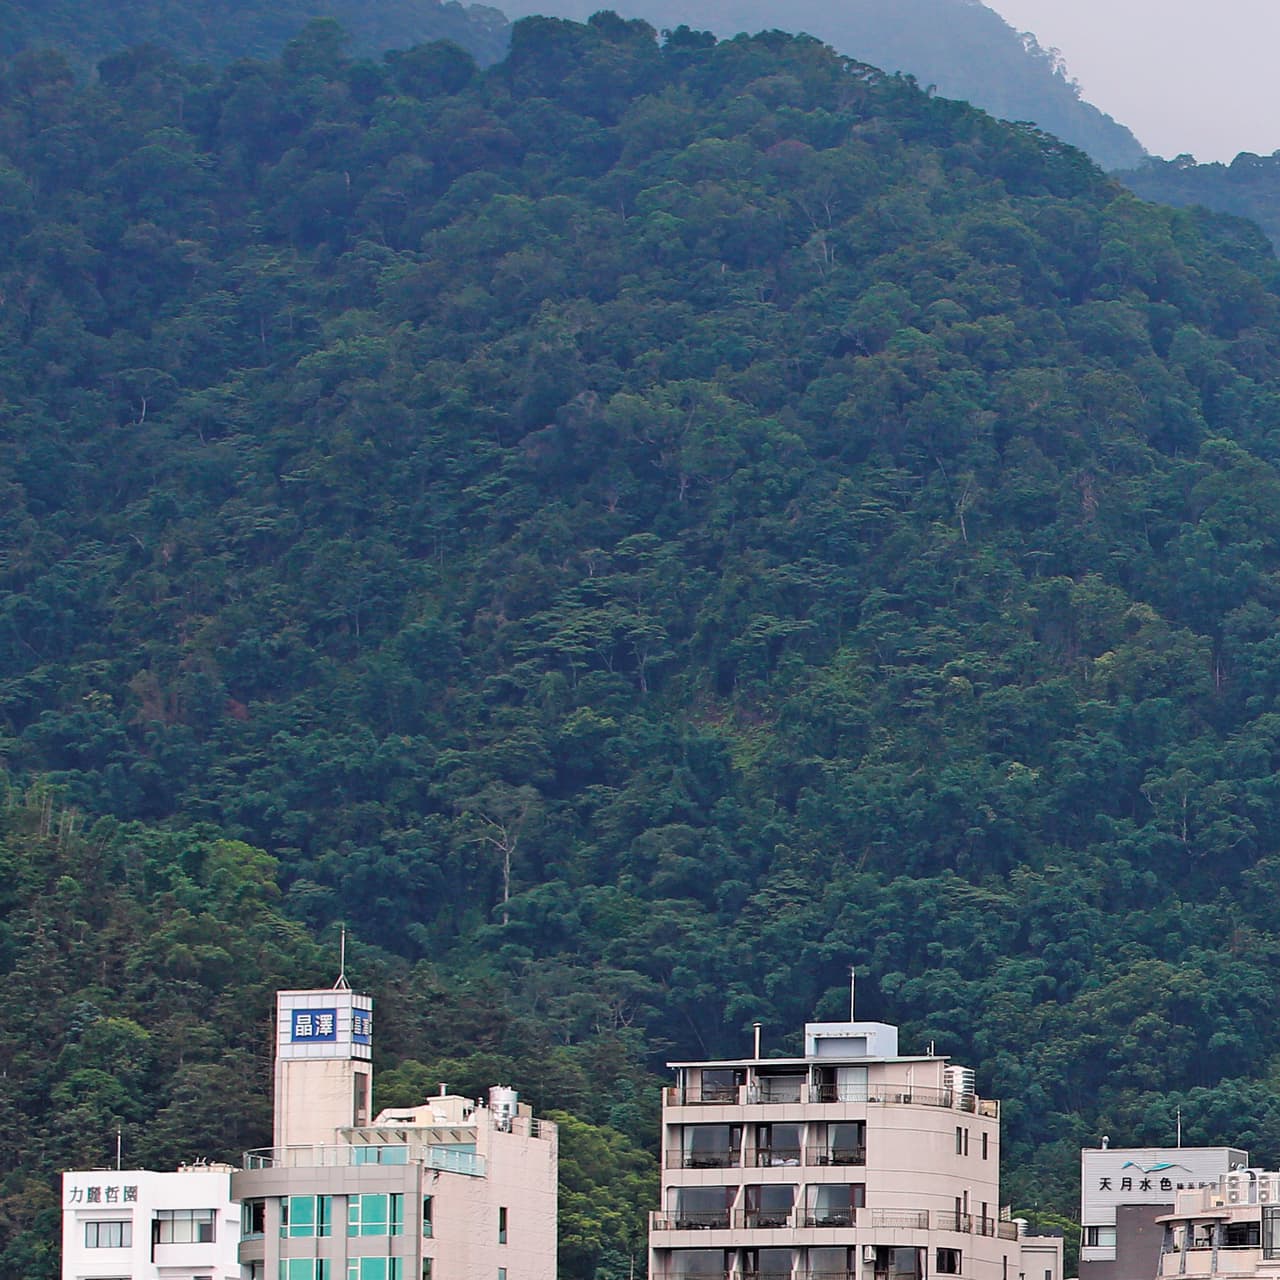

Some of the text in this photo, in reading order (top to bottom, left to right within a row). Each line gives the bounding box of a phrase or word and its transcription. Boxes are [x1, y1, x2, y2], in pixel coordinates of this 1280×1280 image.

[295, 1014, 333, 1036] 晶澤
[1099, 1177, 1173, 1192] 天月水色
